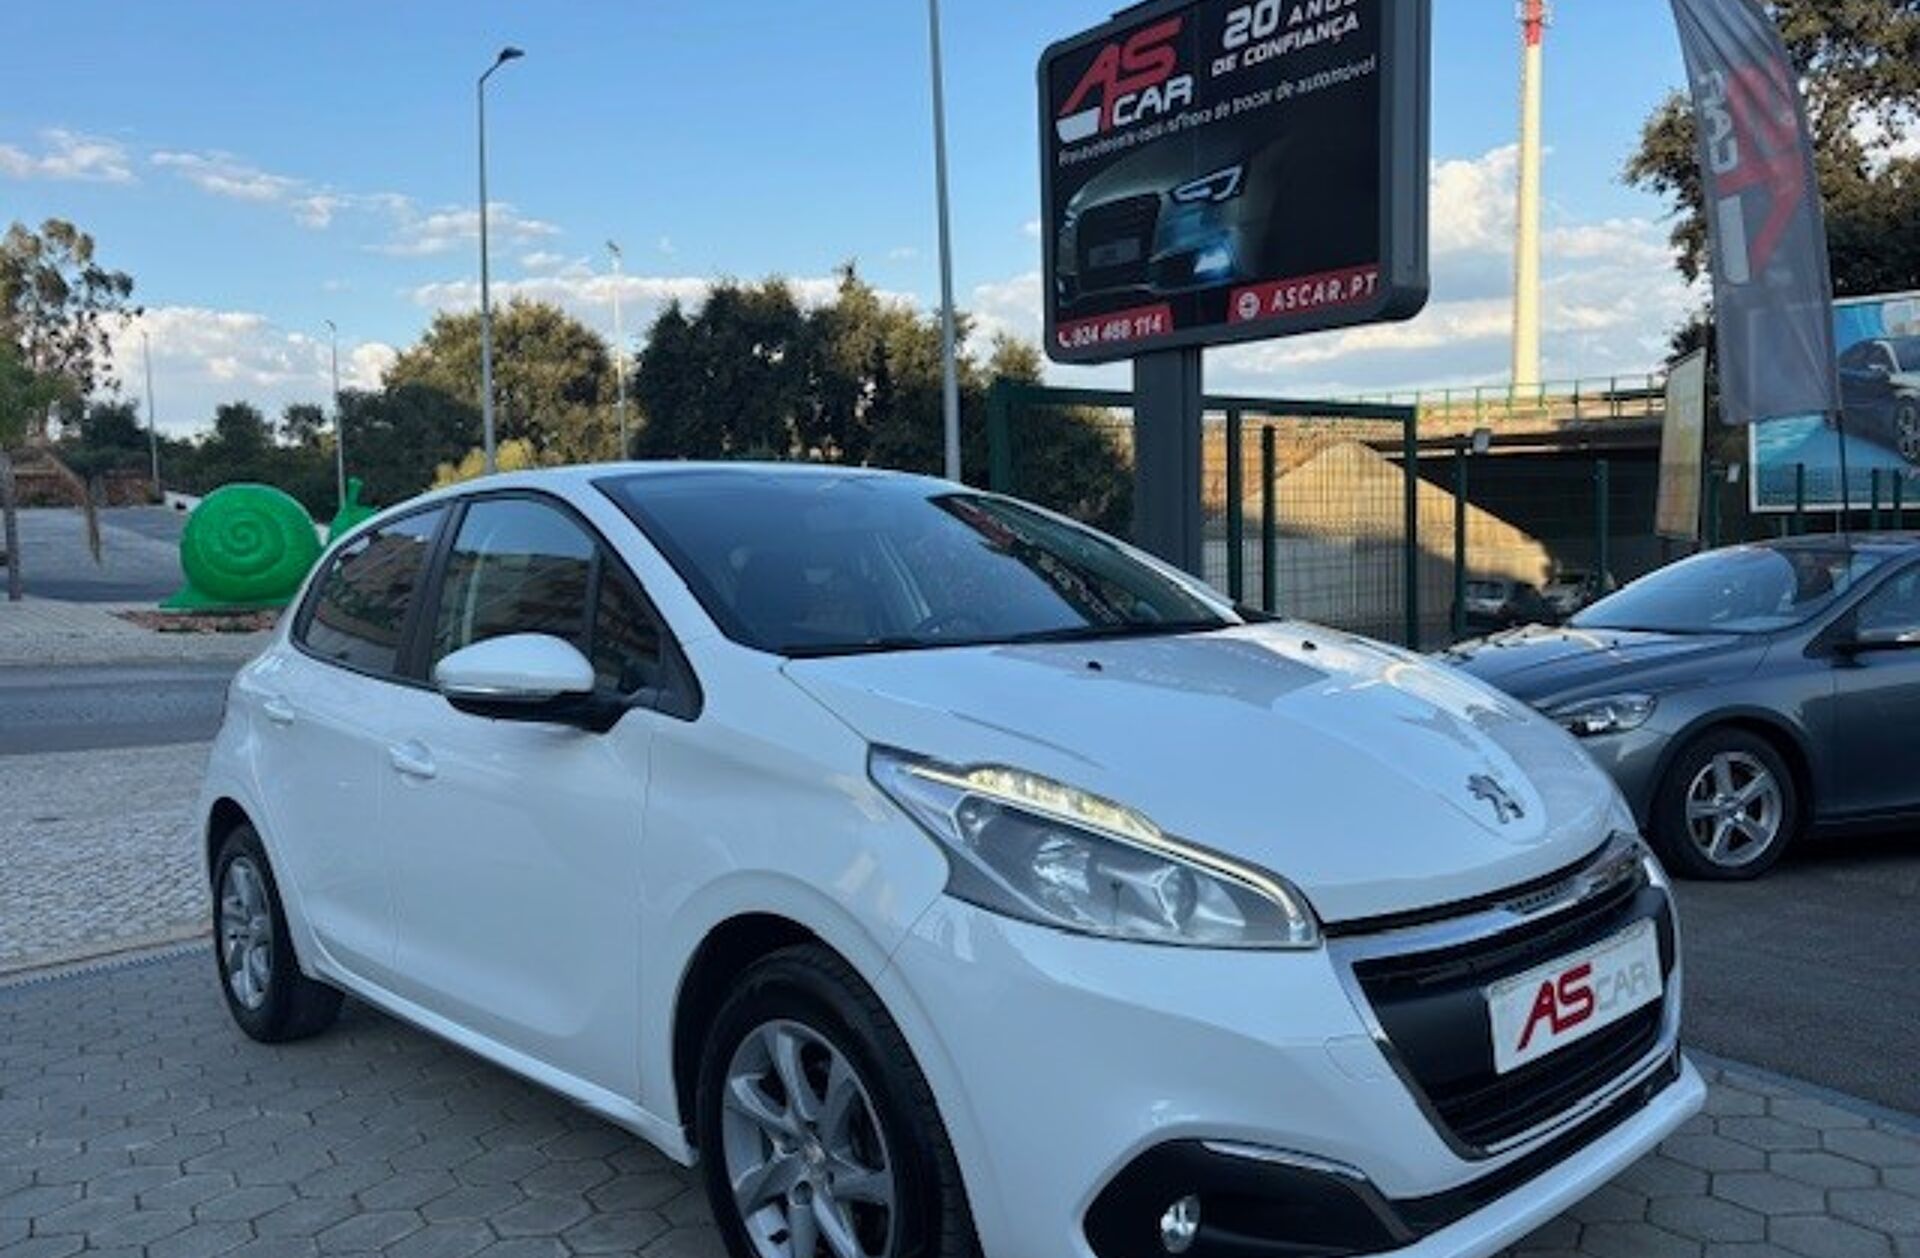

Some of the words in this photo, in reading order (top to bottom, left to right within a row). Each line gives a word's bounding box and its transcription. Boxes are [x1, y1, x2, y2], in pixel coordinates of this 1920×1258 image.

[1211, 55, 1238, 77] DE
[1244, 11, 1359, 66] CONFIANÇA
[1223, 0, 1281, 49] 20
[1058, 16, 1184, 136] AS
[1112, 74, 1193, 126] CAR
[1271, 271, 1379, 312] ASCAR.PT
[1516, 961, 1594, 1052] AS
[1597, 960, 1650, 1011] CAR
